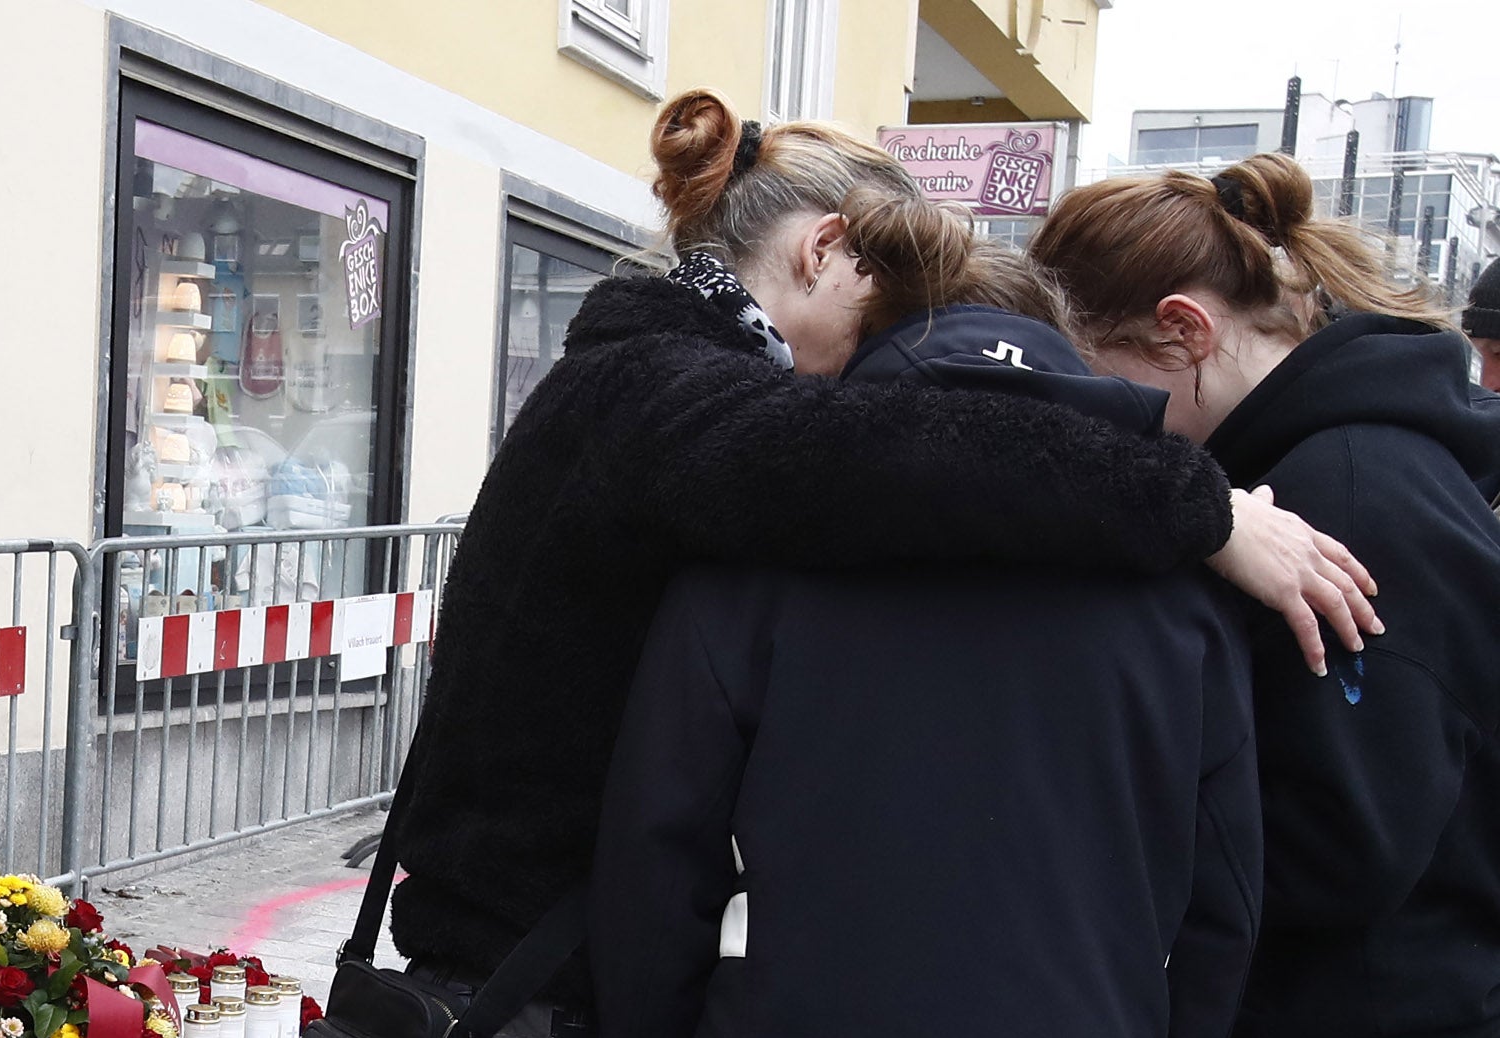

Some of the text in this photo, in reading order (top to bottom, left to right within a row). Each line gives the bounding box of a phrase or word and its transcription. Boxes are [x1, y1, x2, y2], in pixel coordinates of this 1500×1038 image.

[994, 155, 1040, 175] GESCH
[918, 170, 973, 192] venirs
[990, 169, 1037, 191] ENKE
[984, 184, 1030, 209] BOX
[346, 241, 375, 272] GESCH
[350, 283, 379, 323] BOX
